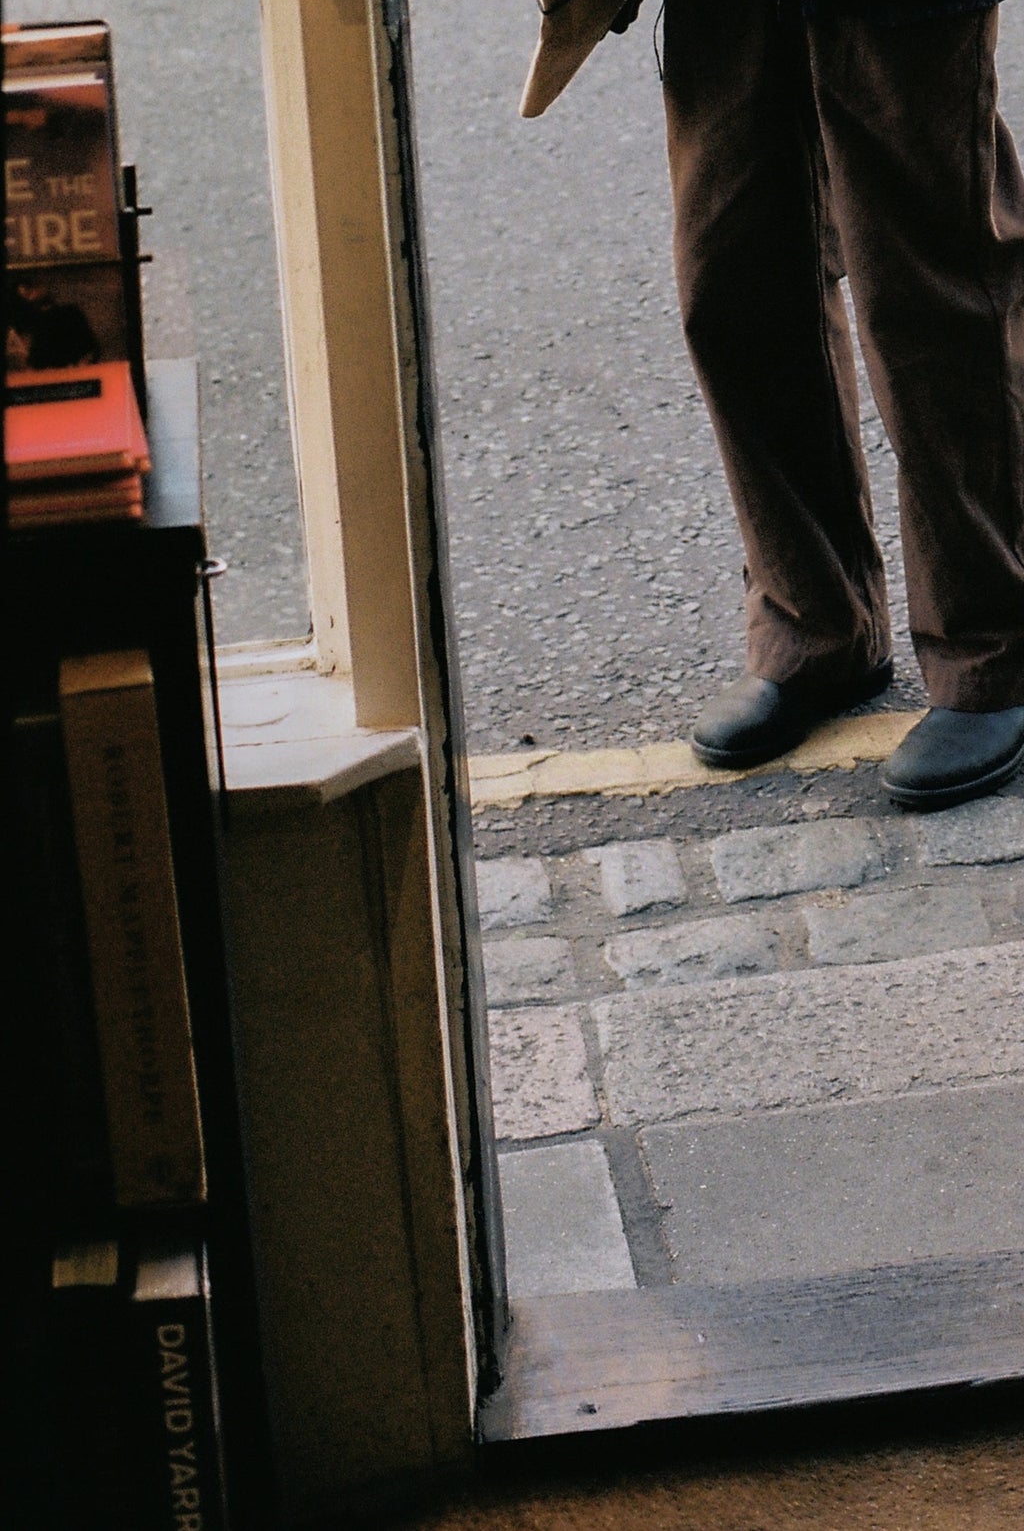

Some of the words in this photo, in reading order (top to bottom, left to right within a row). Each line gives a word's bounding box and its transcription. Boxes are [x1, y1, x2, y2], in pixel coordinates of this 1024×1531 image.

[46, 173, 97, 198] THE
[103, 744, 137, 866] ROBERT
[157, 1323, 194, 1433] DAVID
